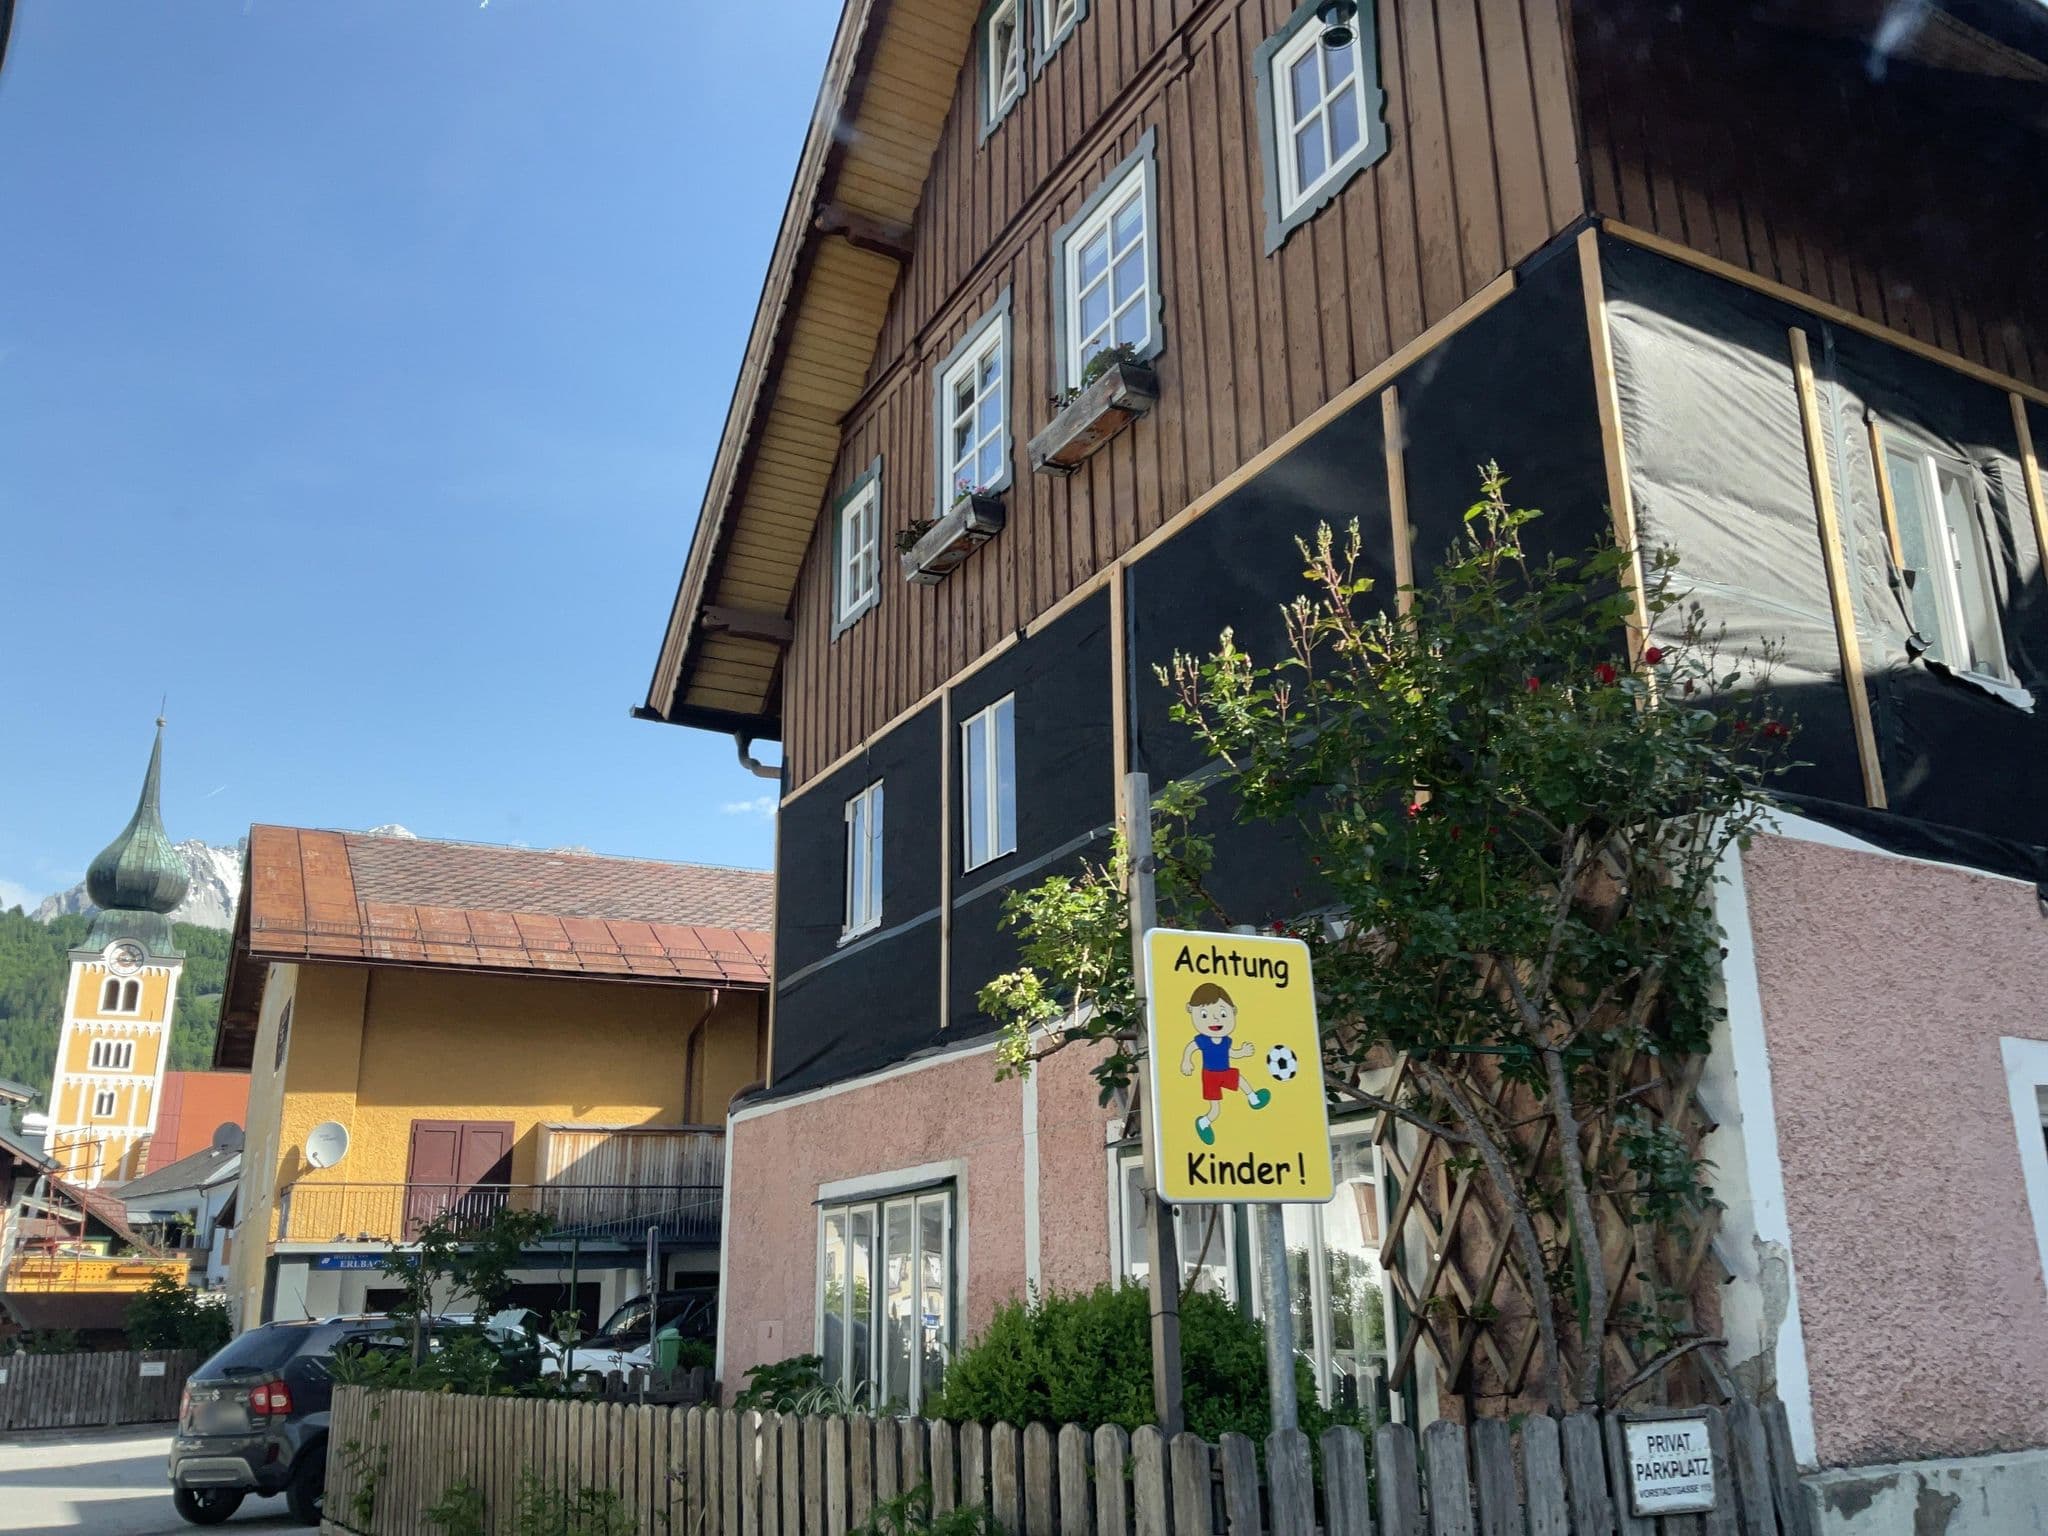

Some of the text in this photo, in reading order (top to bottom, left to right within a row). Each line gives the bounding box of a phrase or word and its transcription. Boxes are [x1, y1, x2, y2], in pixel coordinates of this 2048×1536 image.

[1174, 944, 1290, 988] Achtung
[1647, 1433, 1691, 1454] PRIVAT
[1636, 1458, 1709, 1481] PARKPLATZ
